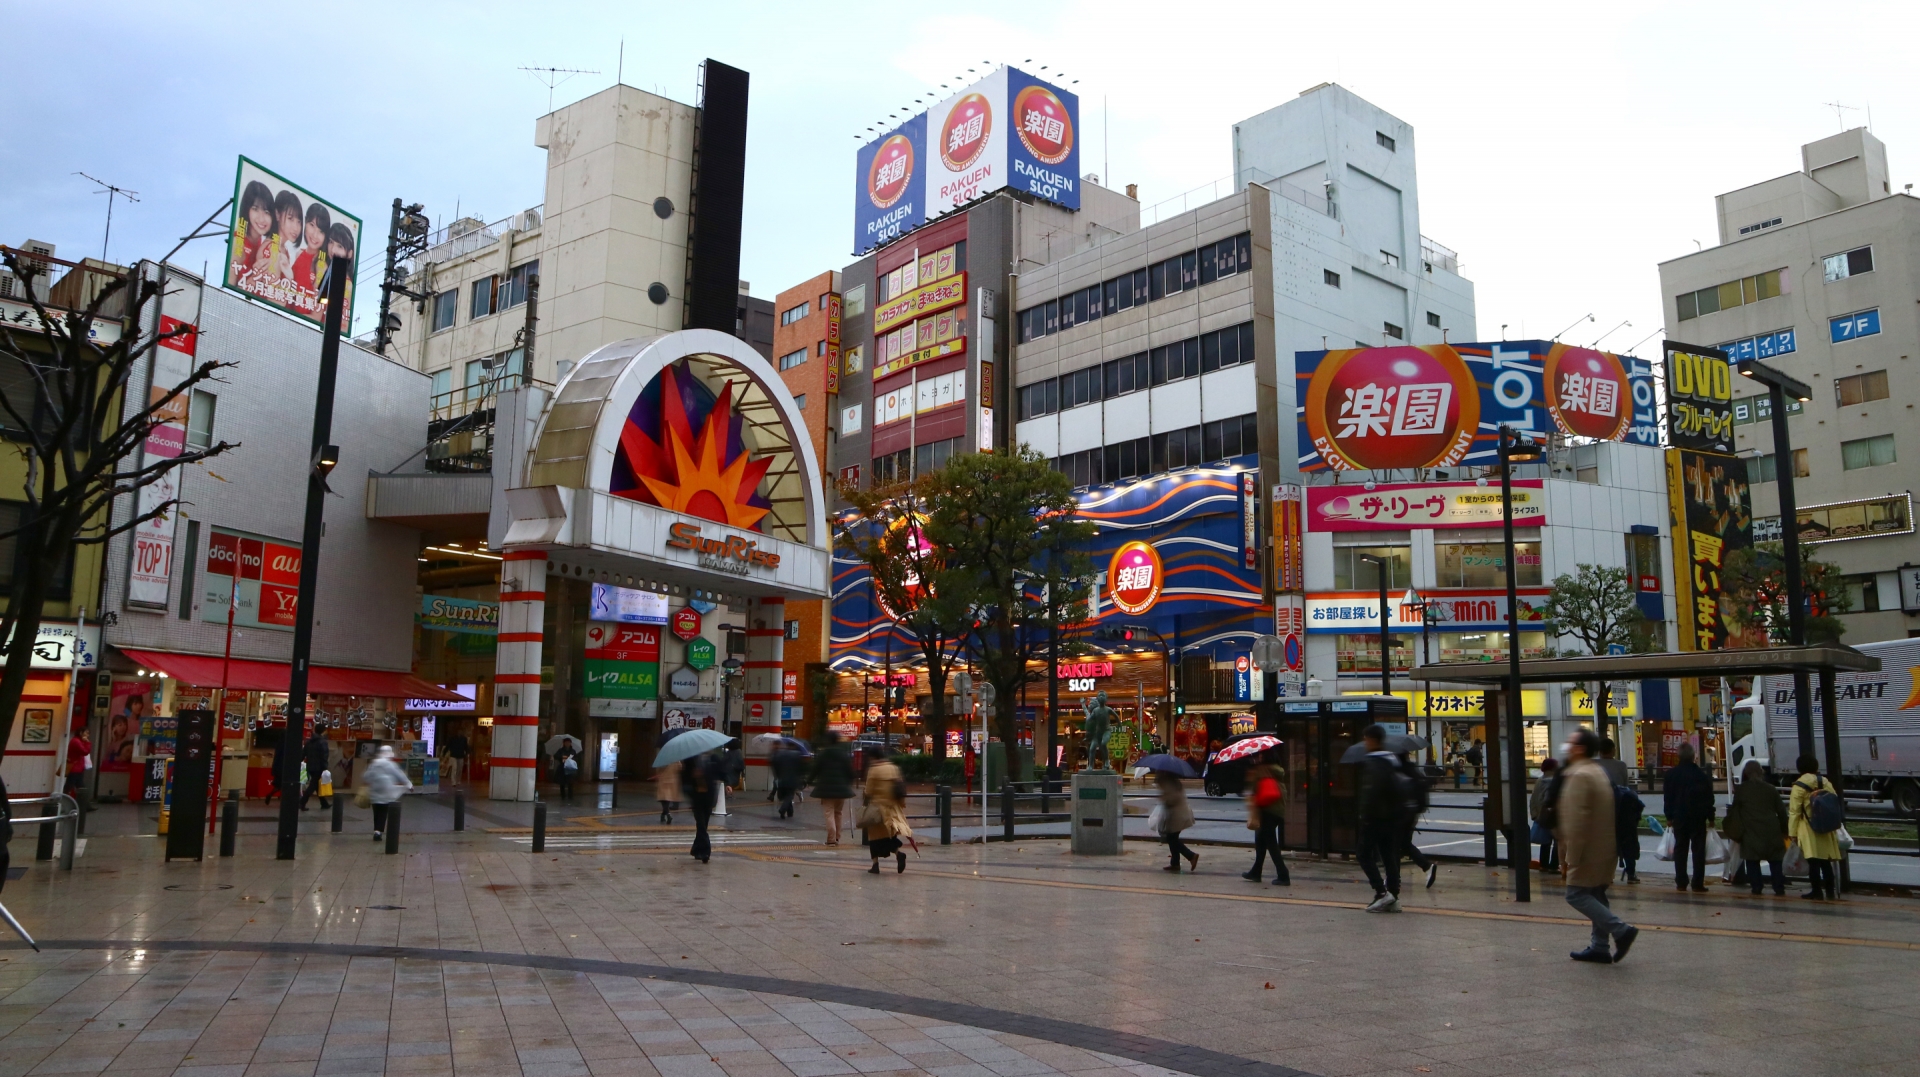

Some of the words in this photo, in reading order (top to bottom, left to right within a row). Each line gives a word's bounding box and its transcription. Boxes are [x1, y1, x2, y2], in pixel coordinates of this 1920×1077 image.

[947, 112, 985, 154] 楽園
[1024, 108, 1065, 144] 楽園
[941, 153, 961, 172] EXCITING
[961, 132, 990, 171] AMUSEMENT
[1015, 126, 1039, 159] EXCITING
[1039, 145, 1071, 164] AMUSEMENT
[875, 154, 907, 192] 楽園
[940, 164, 992, 199] RAKUEN
[1014, 158, 1073, 192] RAKUEN
[886, 172, 912, 208] AMUSEMENT
[952, 185, 979, 207] SLOT
[1029, 179, 1059, 200] SLOT
[867, 202, 912, 235] RAKUEN
[877, 221, 901, 242] SLOT
[231, 260, 321, 297] ヤンジャンのミュー
[890, 253, 953, 294] カラオケ
[880, 299, 911, 322] カラオケ
[917, 281, 962, 310] まねきねこ
[887, 316, 951, 356] カラオケ
[1839, 318, 1869, 338] 7F
[828, 300, 840, 390] カラオケ
[1725, 333, 1792, 357] グエイワ
[982, 366, 990, 403] カラオケ
[1673, 351, 1732, 401] DVD
[1560, 371, 1620, 418] 楽園
[1631, 359, 1657, 446] SLOT
[1335, 382, 1453, 440] 楽園
[1548, 405, 1572, 435] EXCIT
[1611, 416, 1630, 442] MENT
[1677, 404, 1733, 438] ブルーレイ
[147, 433, 183, 450] docomo
[1314, 436, 1356, 471] EXCIT
[1433, 429, 1473, 468] MENT
[1359, 494, 1446, 520] ザ・リーヴ
[1459, 494, 1528, 504] 1室からの空保証
[1497, 506, 1540, 515] リライフ21
[665, 521, 781, 569] SunRise
[1450, 545, 1492, 556] アパート
[137, 544, 162, 575] TOP
[163, 545, 171, 577] 1
[271, 554, 300, 573] au
[1516, 555, 1541, 565] 情報館
[132, 575, 151, 584] mobile
[1116, 564, 1154, 592] 楽園
[1643, 578, 1656, 588] 情報
[1691, 530, 1724, 650] 買います
[217, 593, 253, 609] Sofank
[273, 590, 298, 612] Y!
[430, 598, 499, 623] SunRi
[596, 585, 609, 613] R
[1110, 589, 1131, 613] EXCITING
[1130, 584, 1160, 613] AMUSEMENT
[1454, 600, 1497, 622] mini
[274, 612, 294, 621] mobile
[678, 613, 696, 621] アコム
[1278, 607, 1290, 636] mini
[1293, 607, 1303, 636] mini
[621, 631, 656, 645] アコム
[693, 645, 710, 653] レイク
[616, 651, 628, 660] 3F
[588, 671, 653, 685] レイクALSA
[1057, 662, 1113, 679] RAKUEN
[1068, 678, 1096, 692] SLOT
[1636, 734, 1645, 768] メガネ
[145, 784, 165, 799] お手
